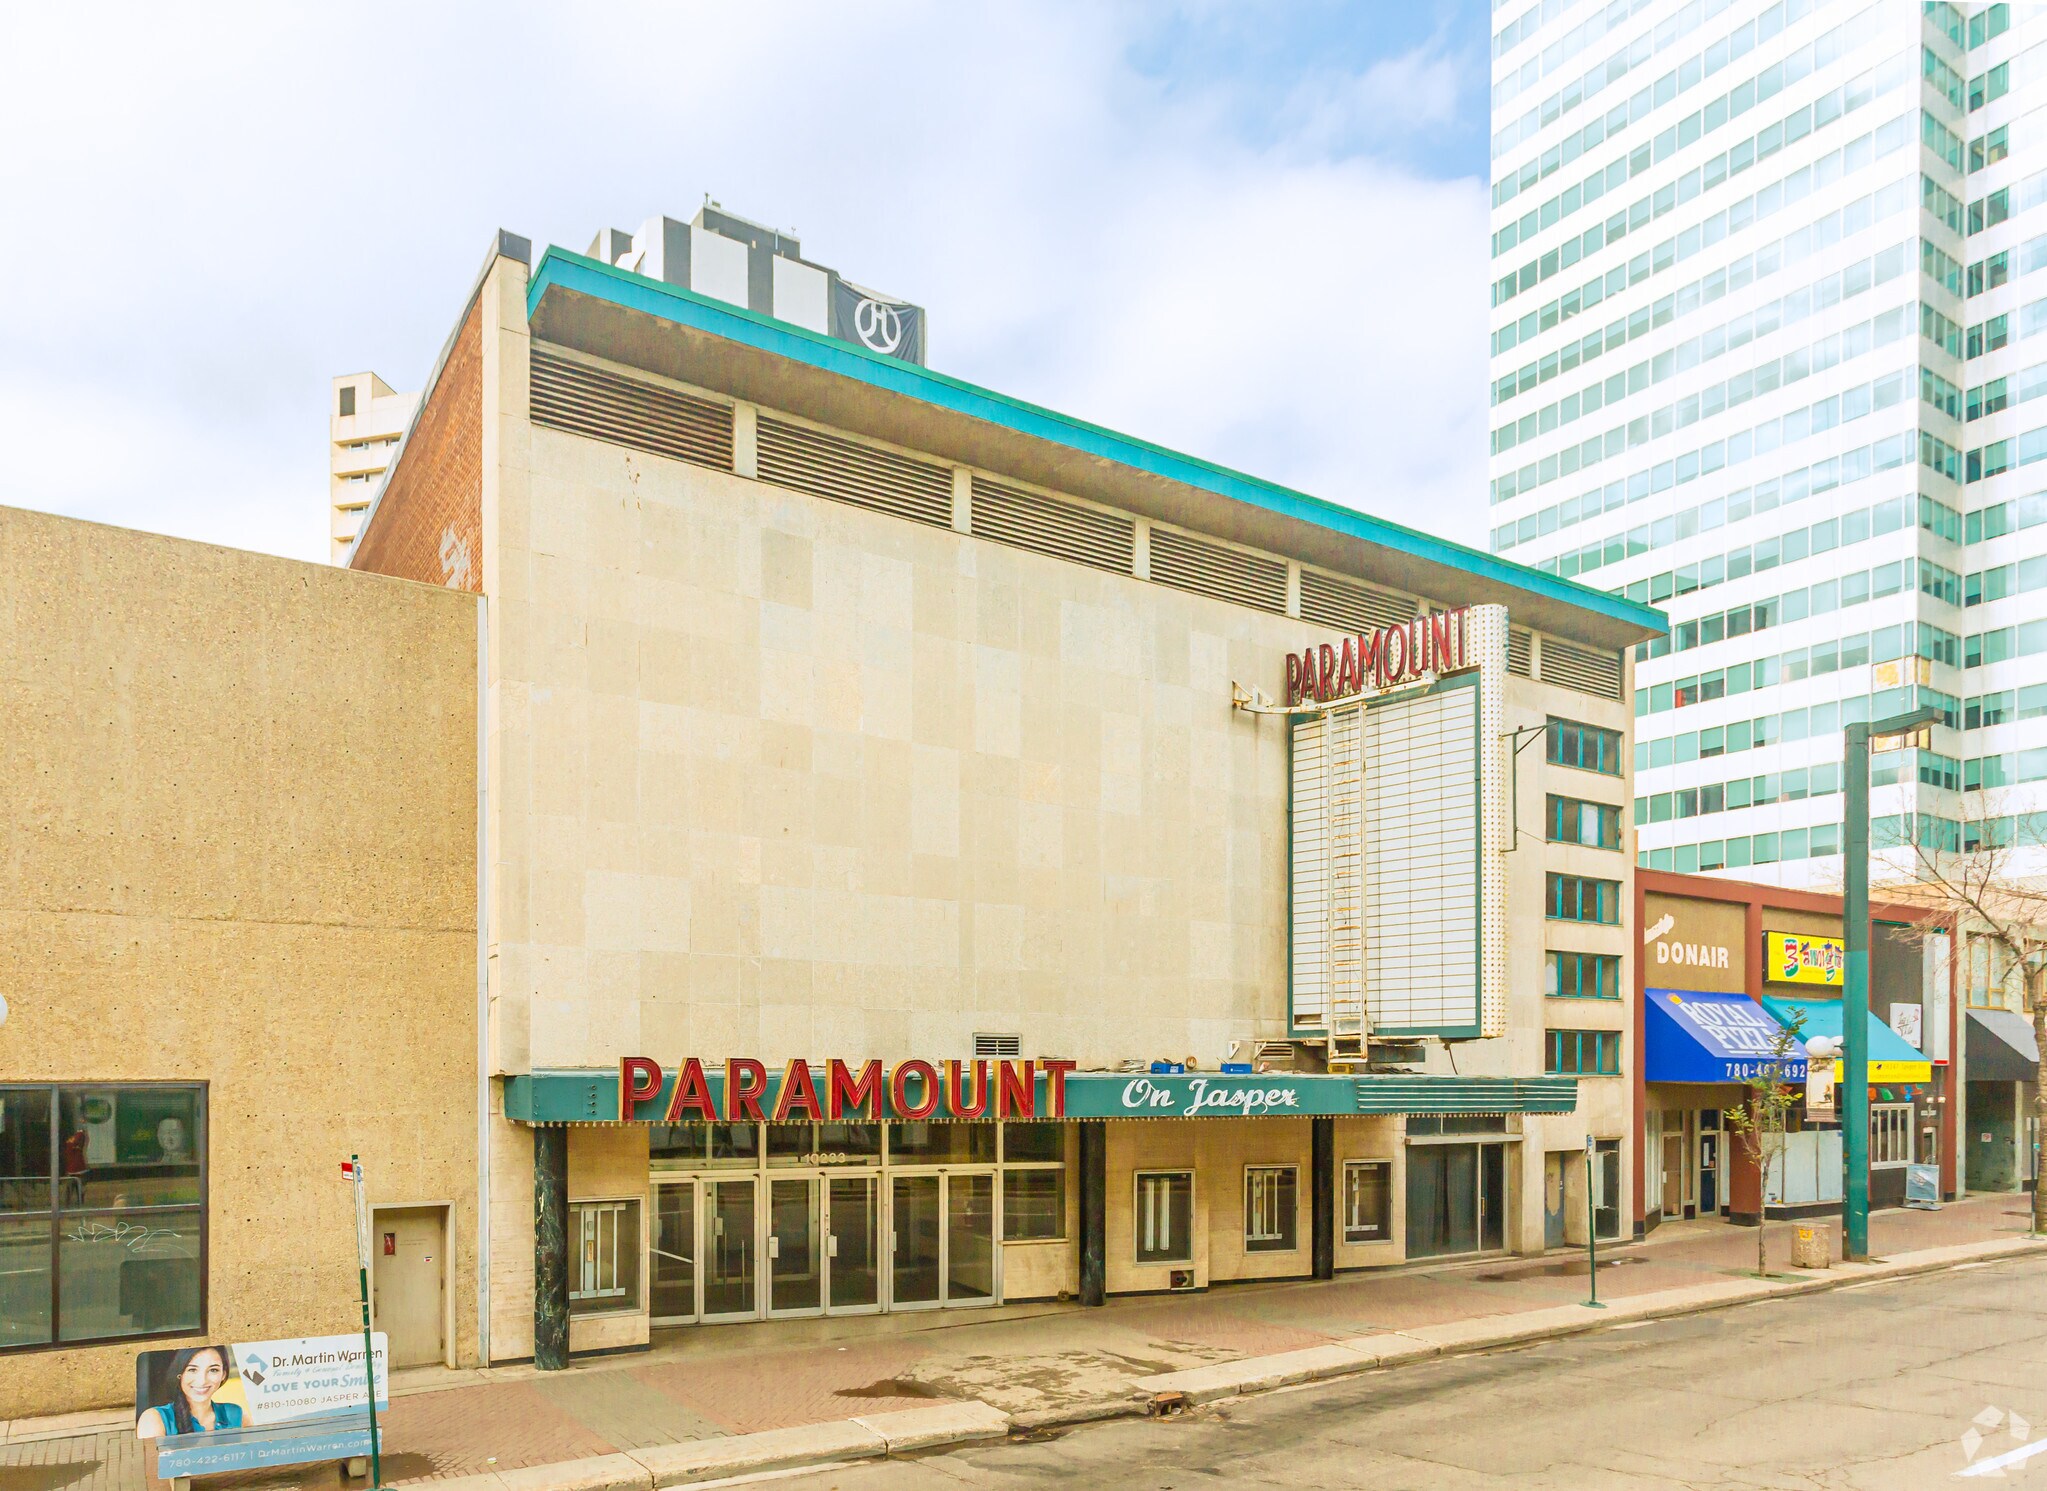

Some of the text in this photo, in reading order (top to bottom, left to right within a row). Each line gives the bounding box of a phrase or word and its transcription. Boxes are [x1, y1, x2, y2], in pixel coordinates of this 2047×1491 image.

[1286, 604, 1472, 706] PARAMOUNT
[1657, 941, 1729, 968] DONAIR
[1783, 937, 1799, 978] 3
[1677, 1001, 1768, 1027] ROYAL
[618, 1056, 1077, 1122] PARAMOUNT
[1121, 1078, 1300, 1116] On Jasper
[272, 1356, 289, 1368] Dr.
[291, 1352, 335, 1366] Martin
[263, 1373, 382, 1393] LOVE YOUR Smie
[257, 1390, 382, 1410] #810-10080 JASPER AE
[169, 1452, 246, 1468] 780-422-6117
